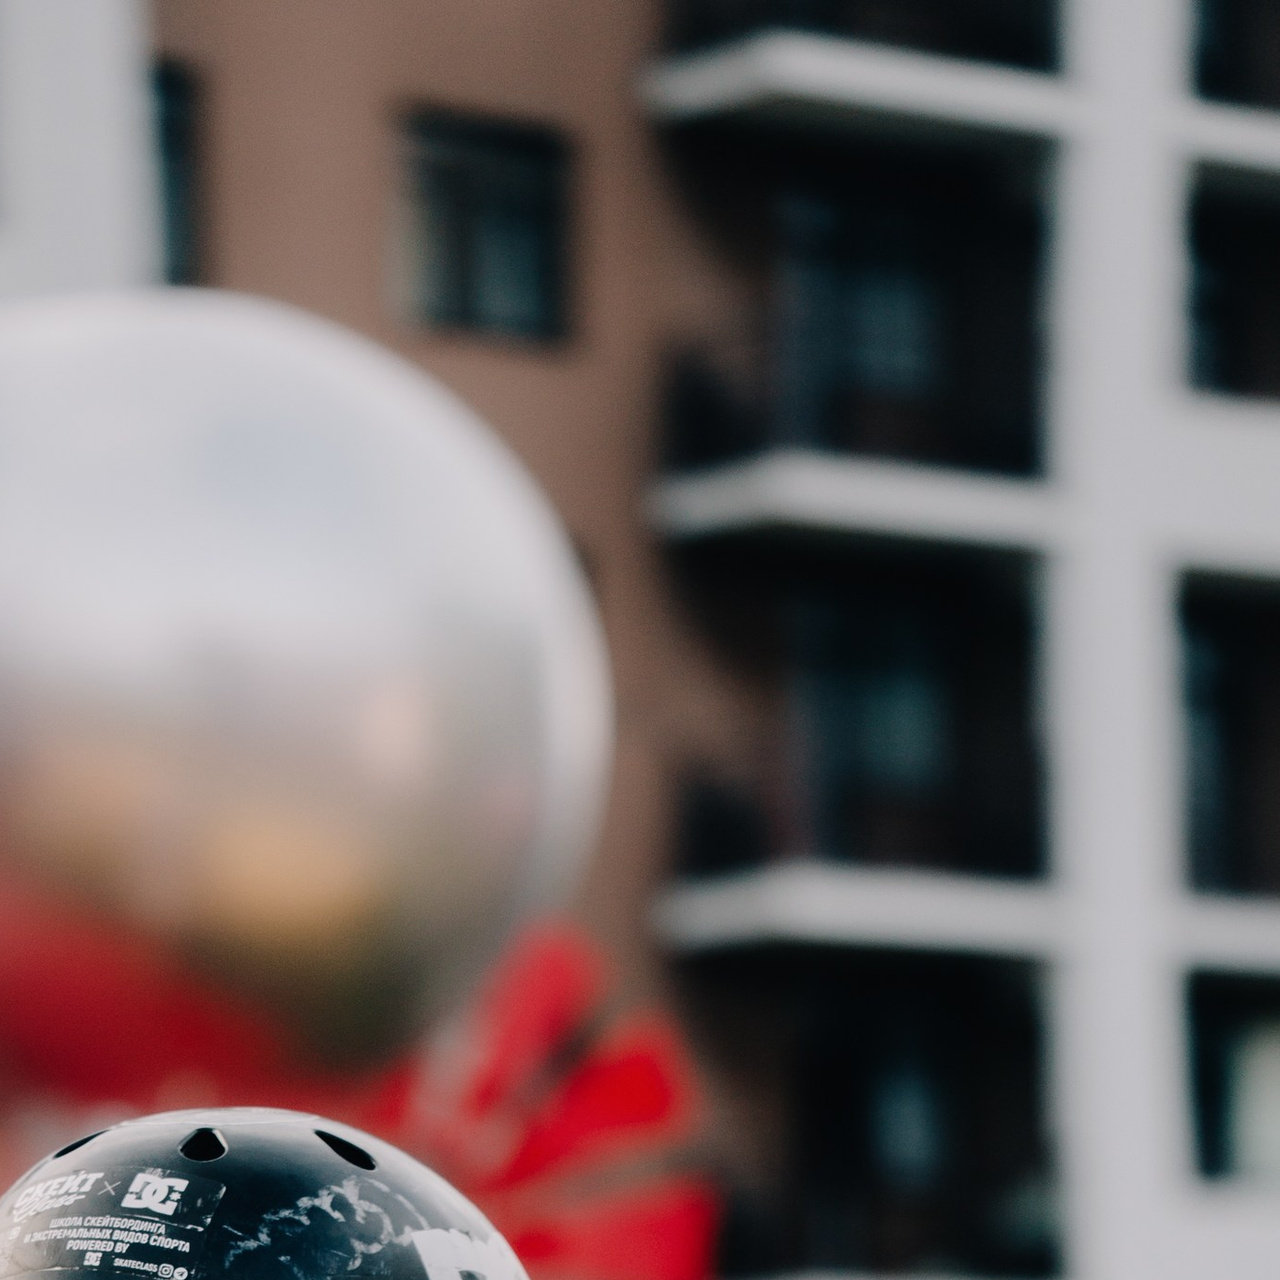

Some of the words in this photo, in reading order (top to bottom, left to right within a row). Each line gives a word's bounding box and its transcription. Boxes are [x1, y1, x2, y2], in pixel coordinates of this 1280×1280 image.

[121, 1172, 189, 1216] DC
[49, 1216, 82, 1228] ШКОЛА
[83, 1215, 166, 1235] СКЕЙТБОРДИНГА
[31, 1228, 112, 1242] ЭКСТРЕМАЛЬНЫХ
[112, 1229, 149, 1244] ВИДОВ
[149, 1235, 190, 1253] СПОРТА
[66, 1240, 114, 1252] POWERED
[114, 1242, 130, 1254] BY
[113, 1258, 158, 1272] SKATECLASS
